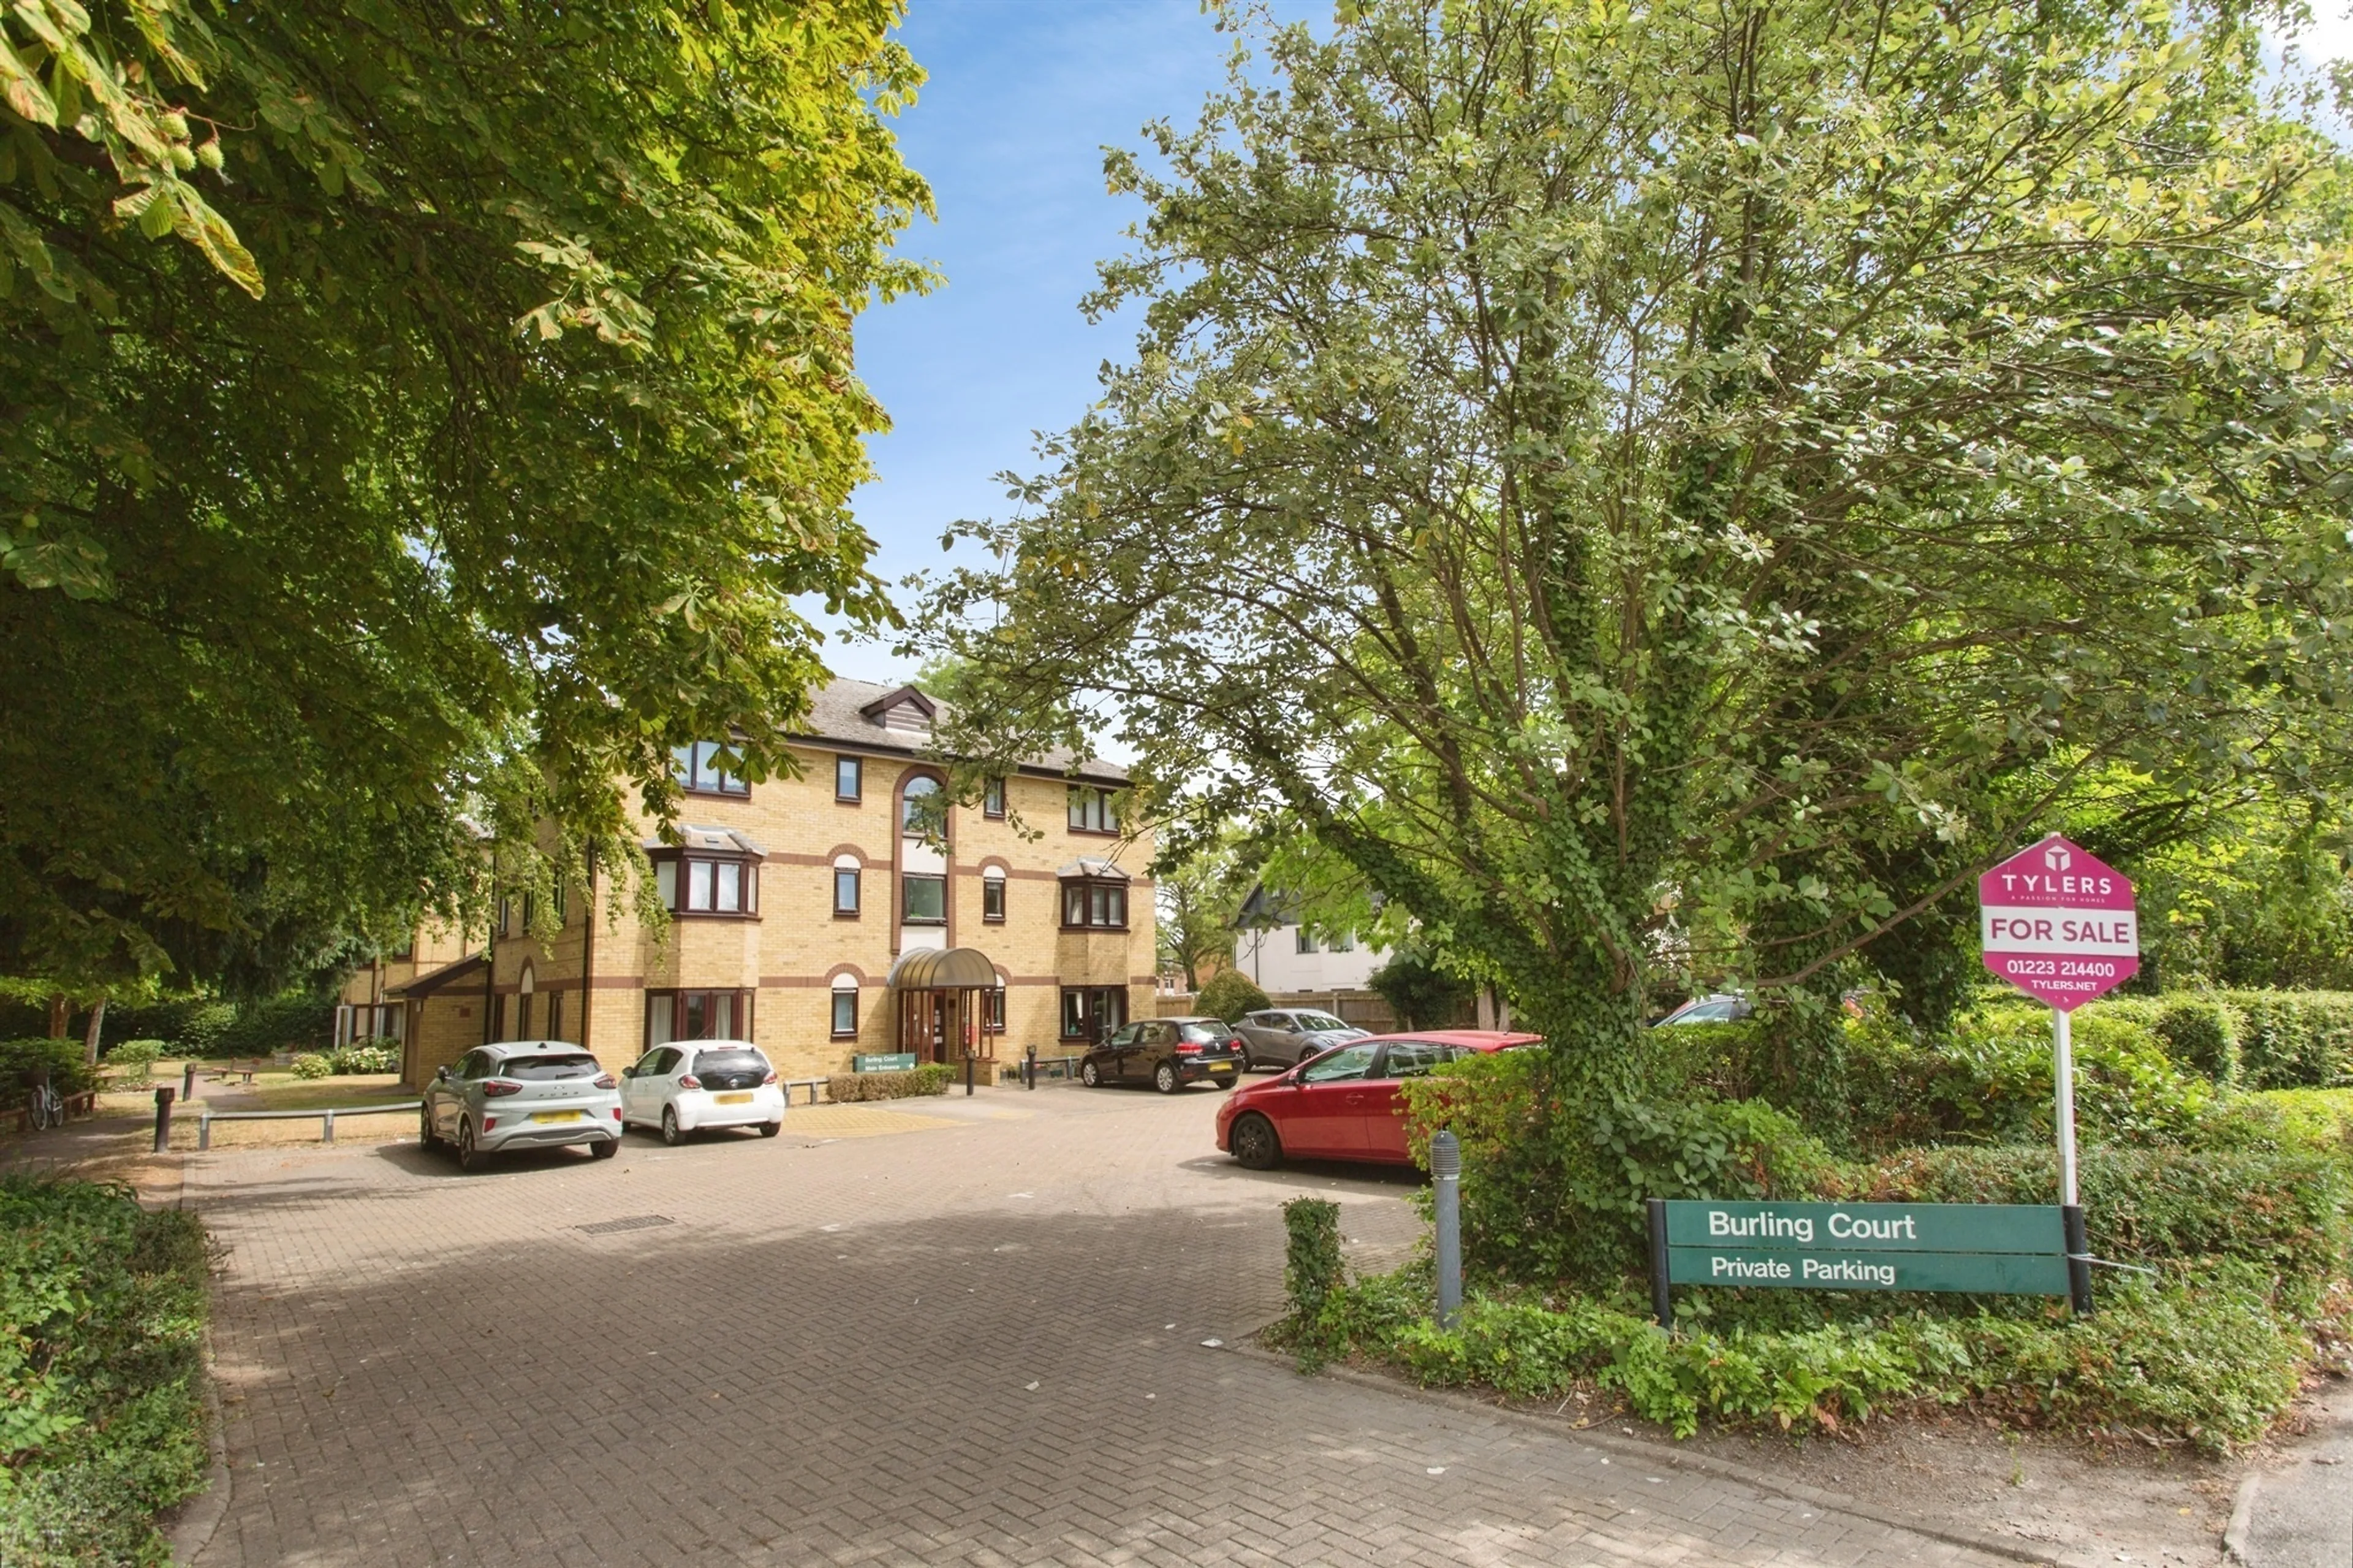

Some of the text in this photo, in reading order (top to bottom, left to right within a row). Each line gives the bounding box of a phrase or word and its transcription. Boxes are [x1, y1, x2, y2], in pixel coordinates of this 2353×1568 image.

[2001, 874, 2112, 895] TYLERS
[1991, 918, 2130, 944] FOR SALE
[2007, 960, 2115, 977] 01223 214400
[2032, 980, 2097, 991] TYLERS.NET
[1708, 1211, 1917, 1242] Burling Court
[1711, 1256, 1895, 1286] Private Parking
